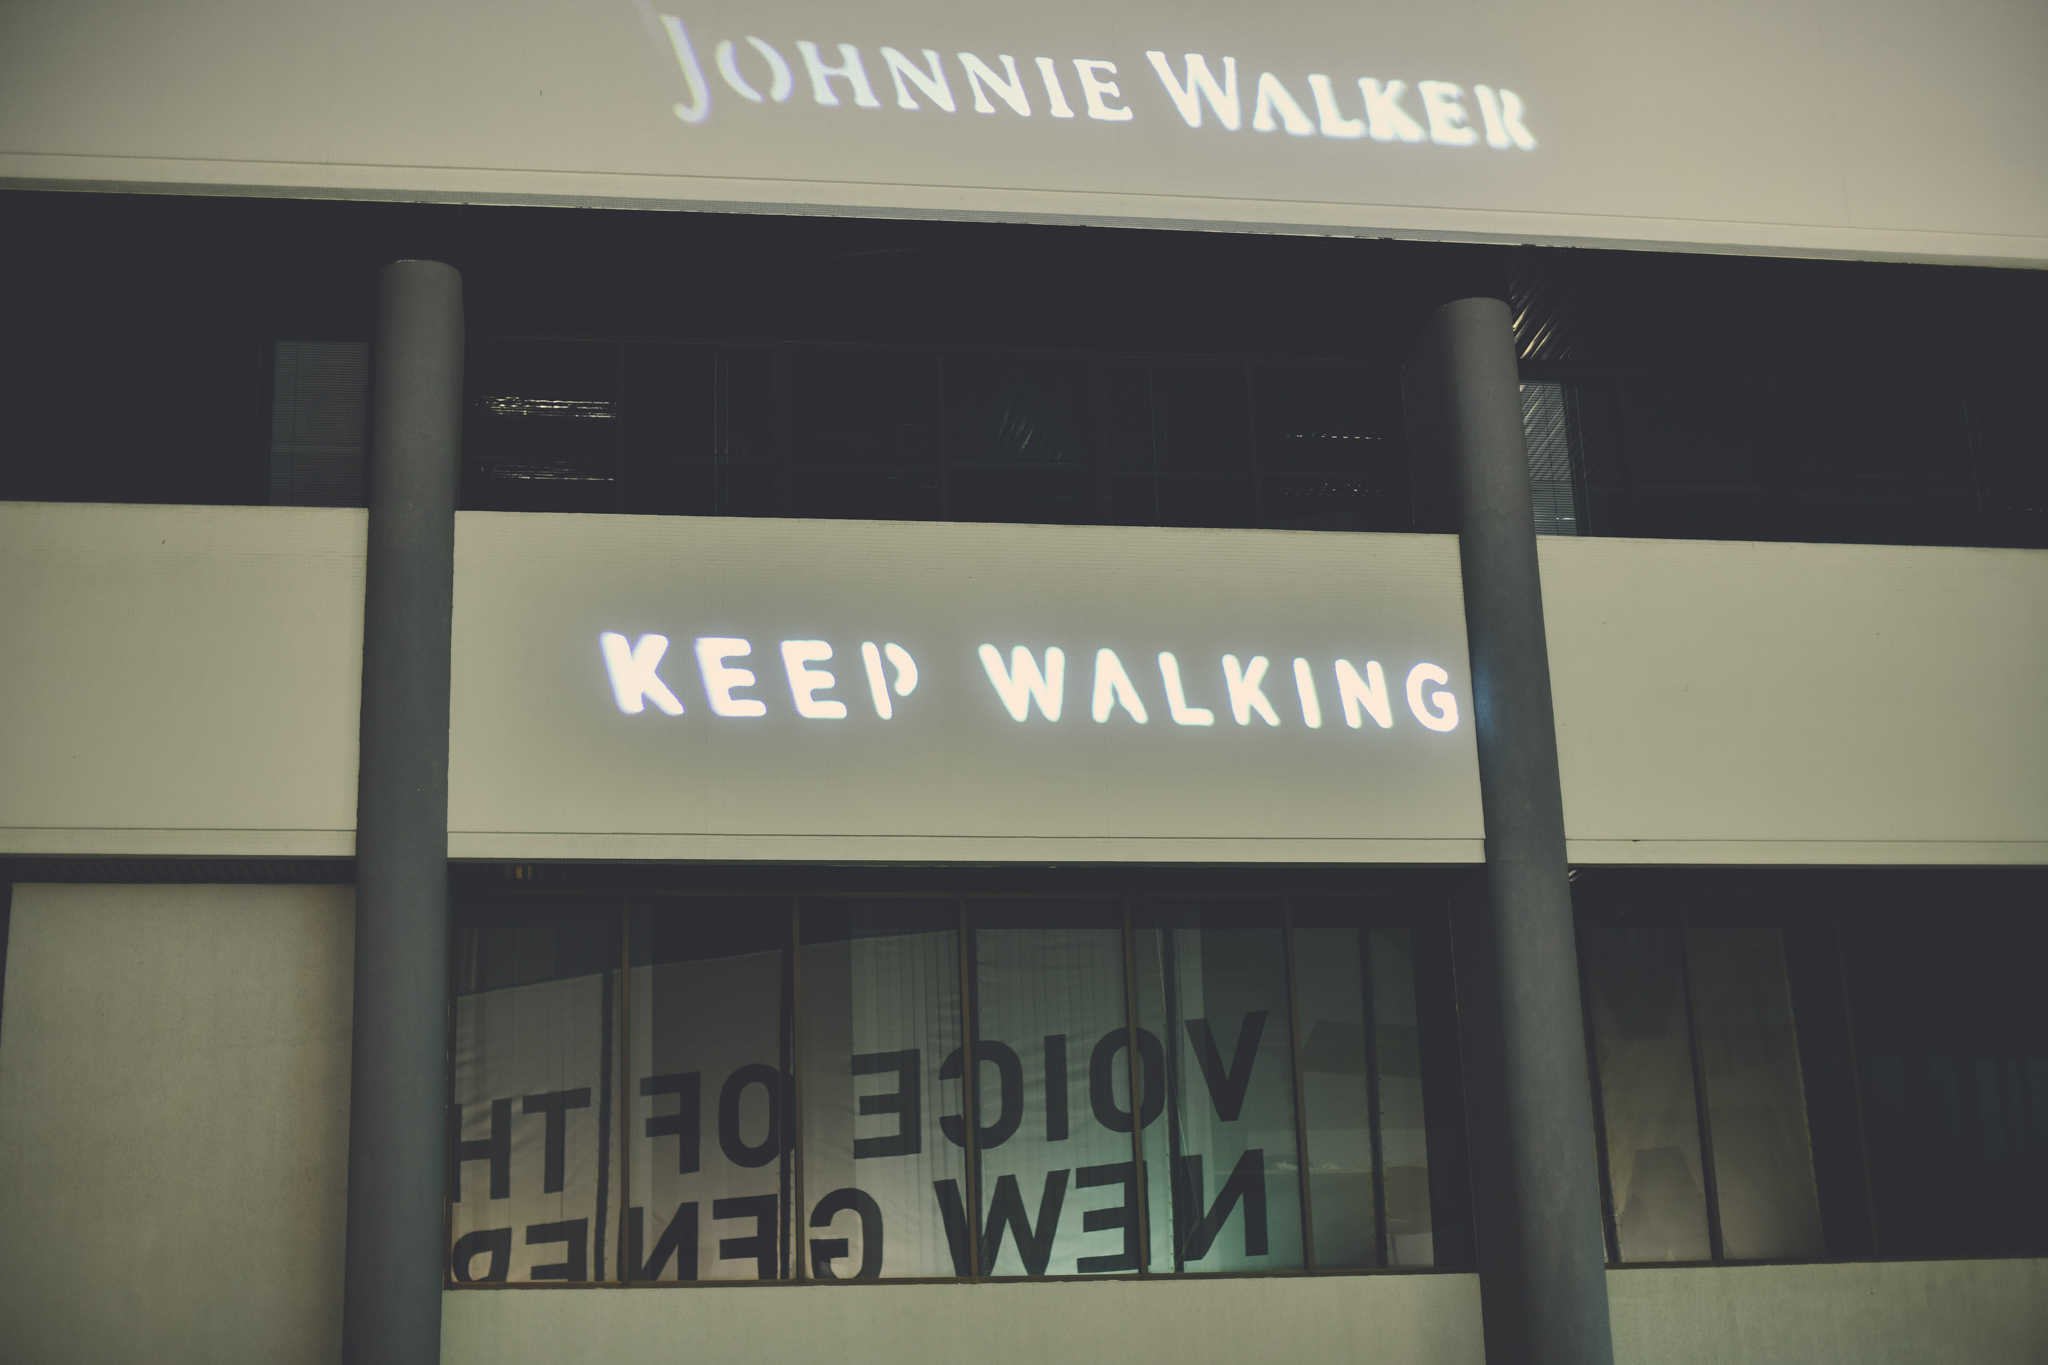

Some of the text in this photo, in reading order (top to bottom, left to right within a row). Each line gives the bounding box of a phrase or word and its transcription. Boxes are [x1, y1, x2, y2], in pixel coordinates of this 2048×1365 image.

[660, 13, 1537, 150] JOHNNIE WALKER
[599, 631, 1461, 732] KEEP WALKING
